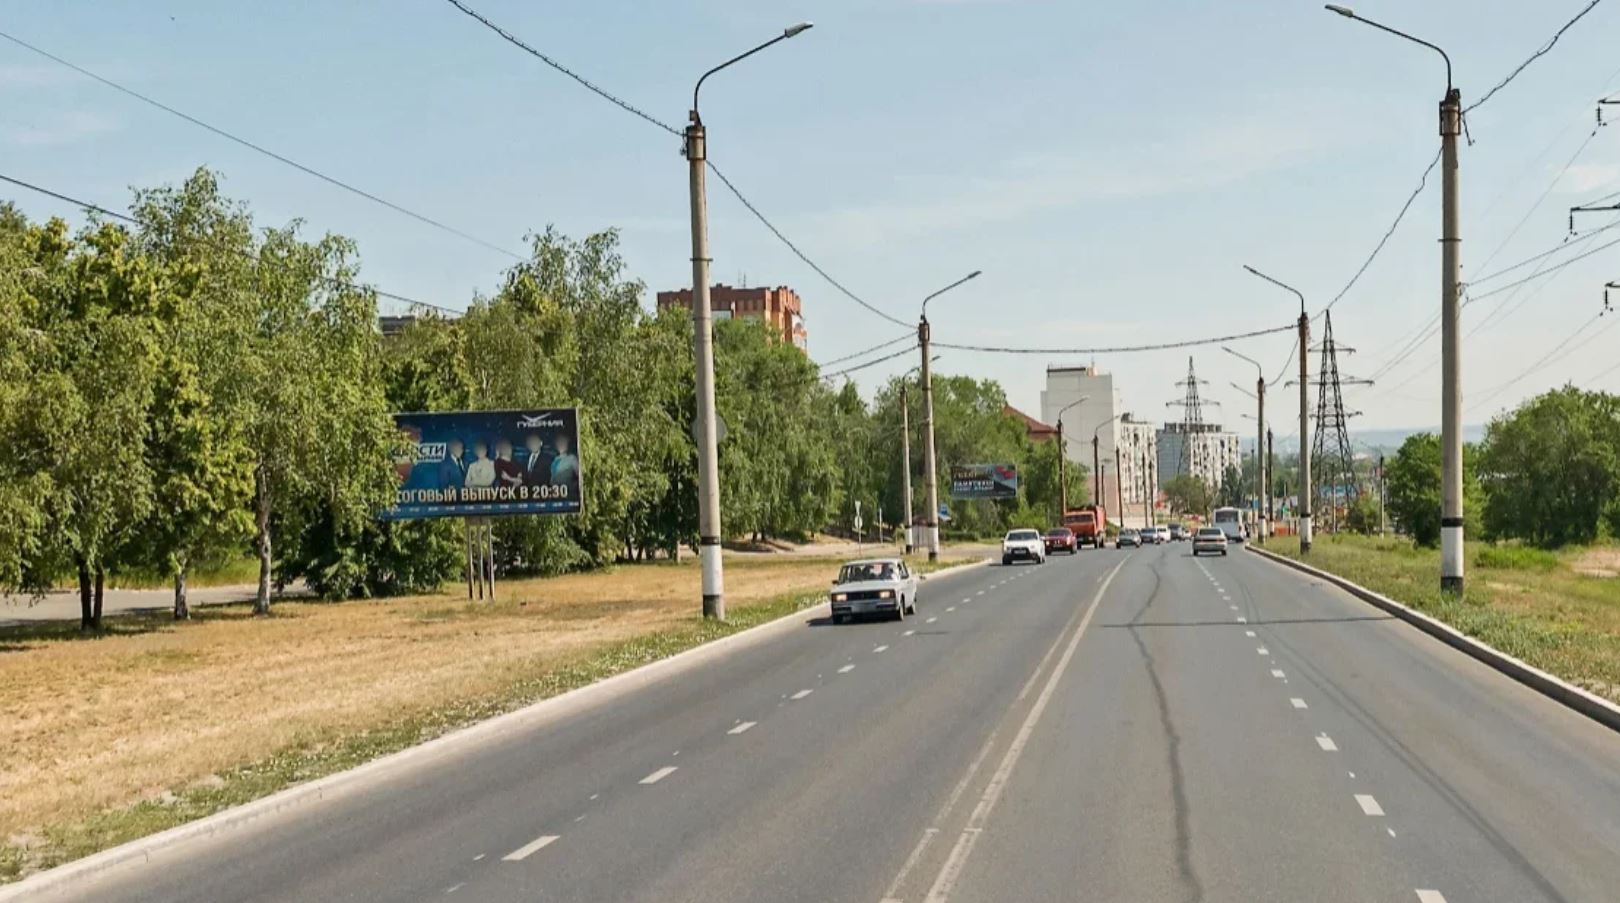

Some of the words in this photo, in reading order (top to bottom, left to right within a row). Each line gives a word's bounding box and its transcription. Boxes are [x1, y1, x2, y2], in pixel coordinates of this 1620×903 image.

[396, 486, 457, 503] ТОГОВЫЙ
[462, 485, 517, 502] ВЫПУСК
[520, 486, 530, 500] В
[532, 485, 568, 499] 20:30
